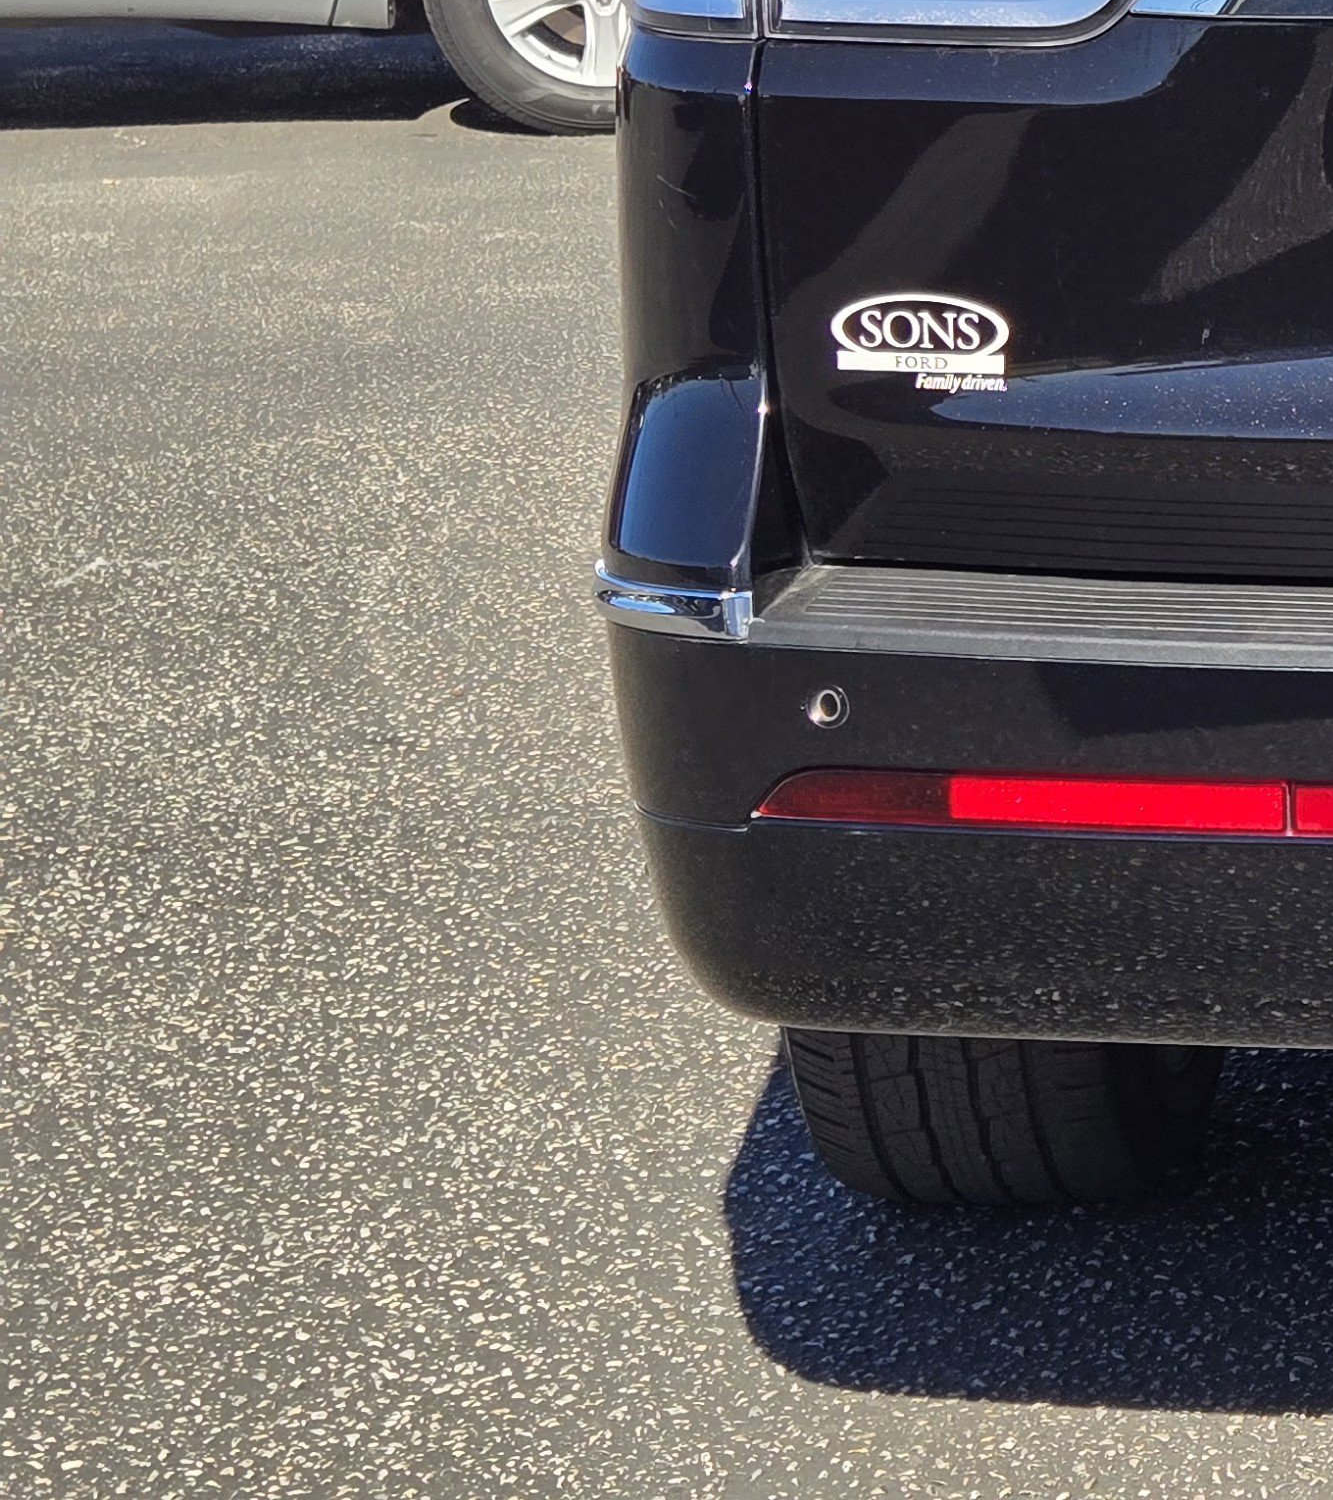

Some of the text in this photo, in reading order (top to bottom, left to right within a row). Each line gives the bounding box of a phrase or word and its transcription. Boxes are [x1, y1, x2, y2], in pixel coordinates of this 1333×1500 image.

[859, 310, 981, 350] SONS
[895, 356, 948, 369] FORD
[915, 373, 962, 394] Family
